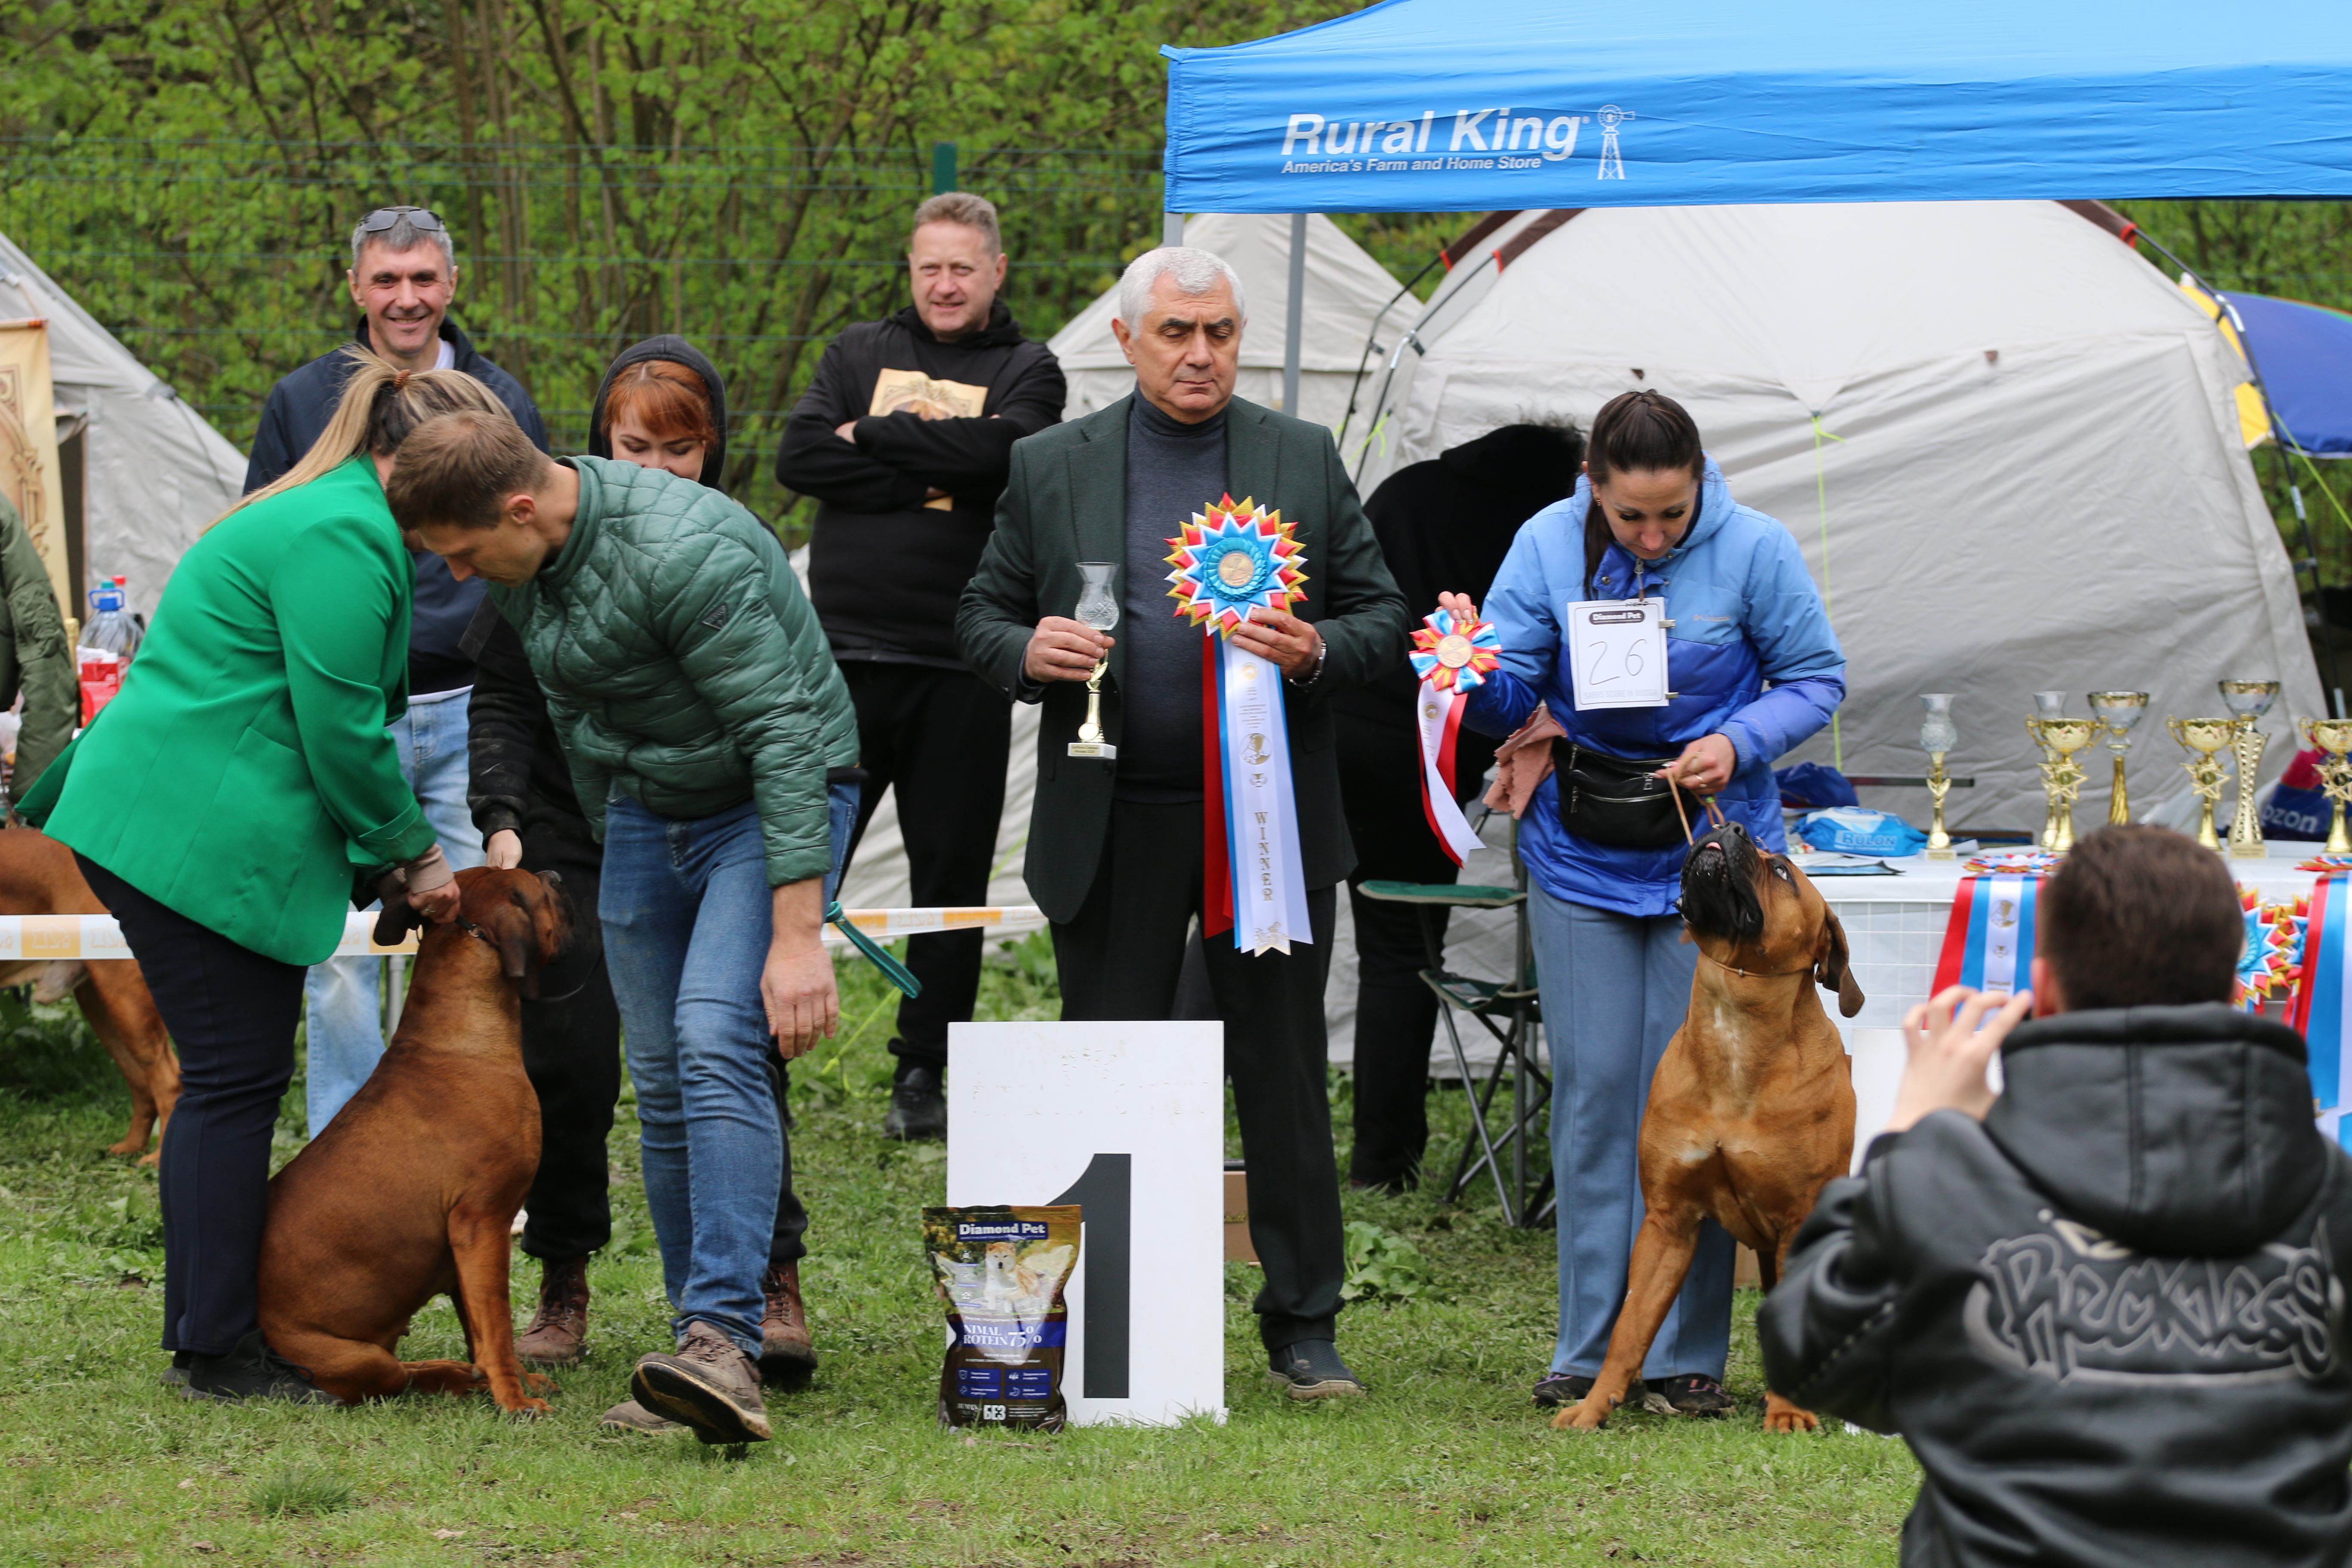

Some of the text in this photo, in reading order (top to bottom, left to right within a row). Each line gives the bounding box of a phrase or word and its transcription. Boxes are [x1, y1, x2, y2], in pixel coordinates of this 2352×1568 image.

[1281, 107, 1582, 161] Rural King
[1281, 156, 1541, 173] America's Farm and Home Store
[1592, 612, 1626, 621] Diamond
[1588, 639, 1648, 685] 26
[1843, 832, 1896, 845] RULON
[1254, 811, 1274, 901] WINNER
[959, 1223, 1046, 1235] Diamond Pet
[1044, 1153, 1131, 1398] 1
